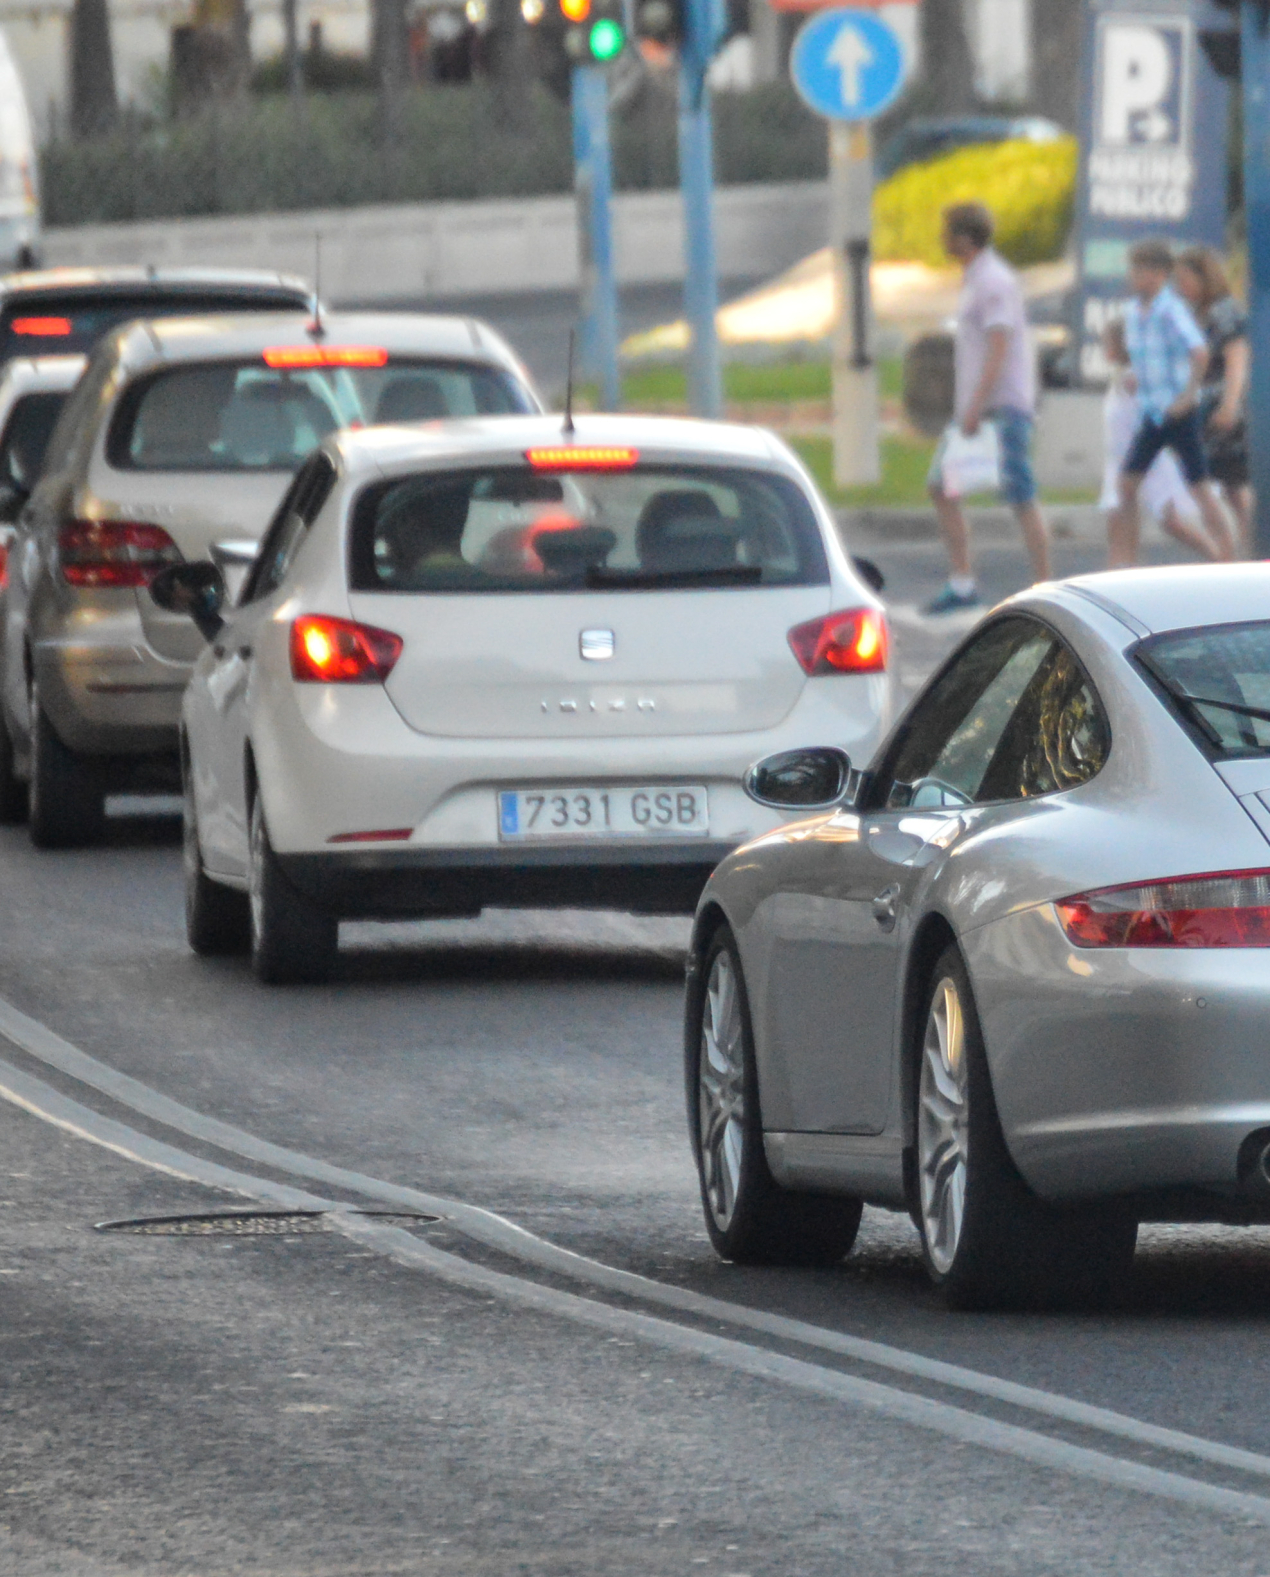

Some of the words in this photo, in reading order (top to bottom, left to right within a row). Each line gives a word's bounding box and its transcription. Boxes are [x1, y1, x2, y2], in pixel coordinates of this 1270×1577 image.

[1101, 24, 1172, 145] P
[525, 793, 612, 828] 7331
[630, 792, 697, 825] GSB
